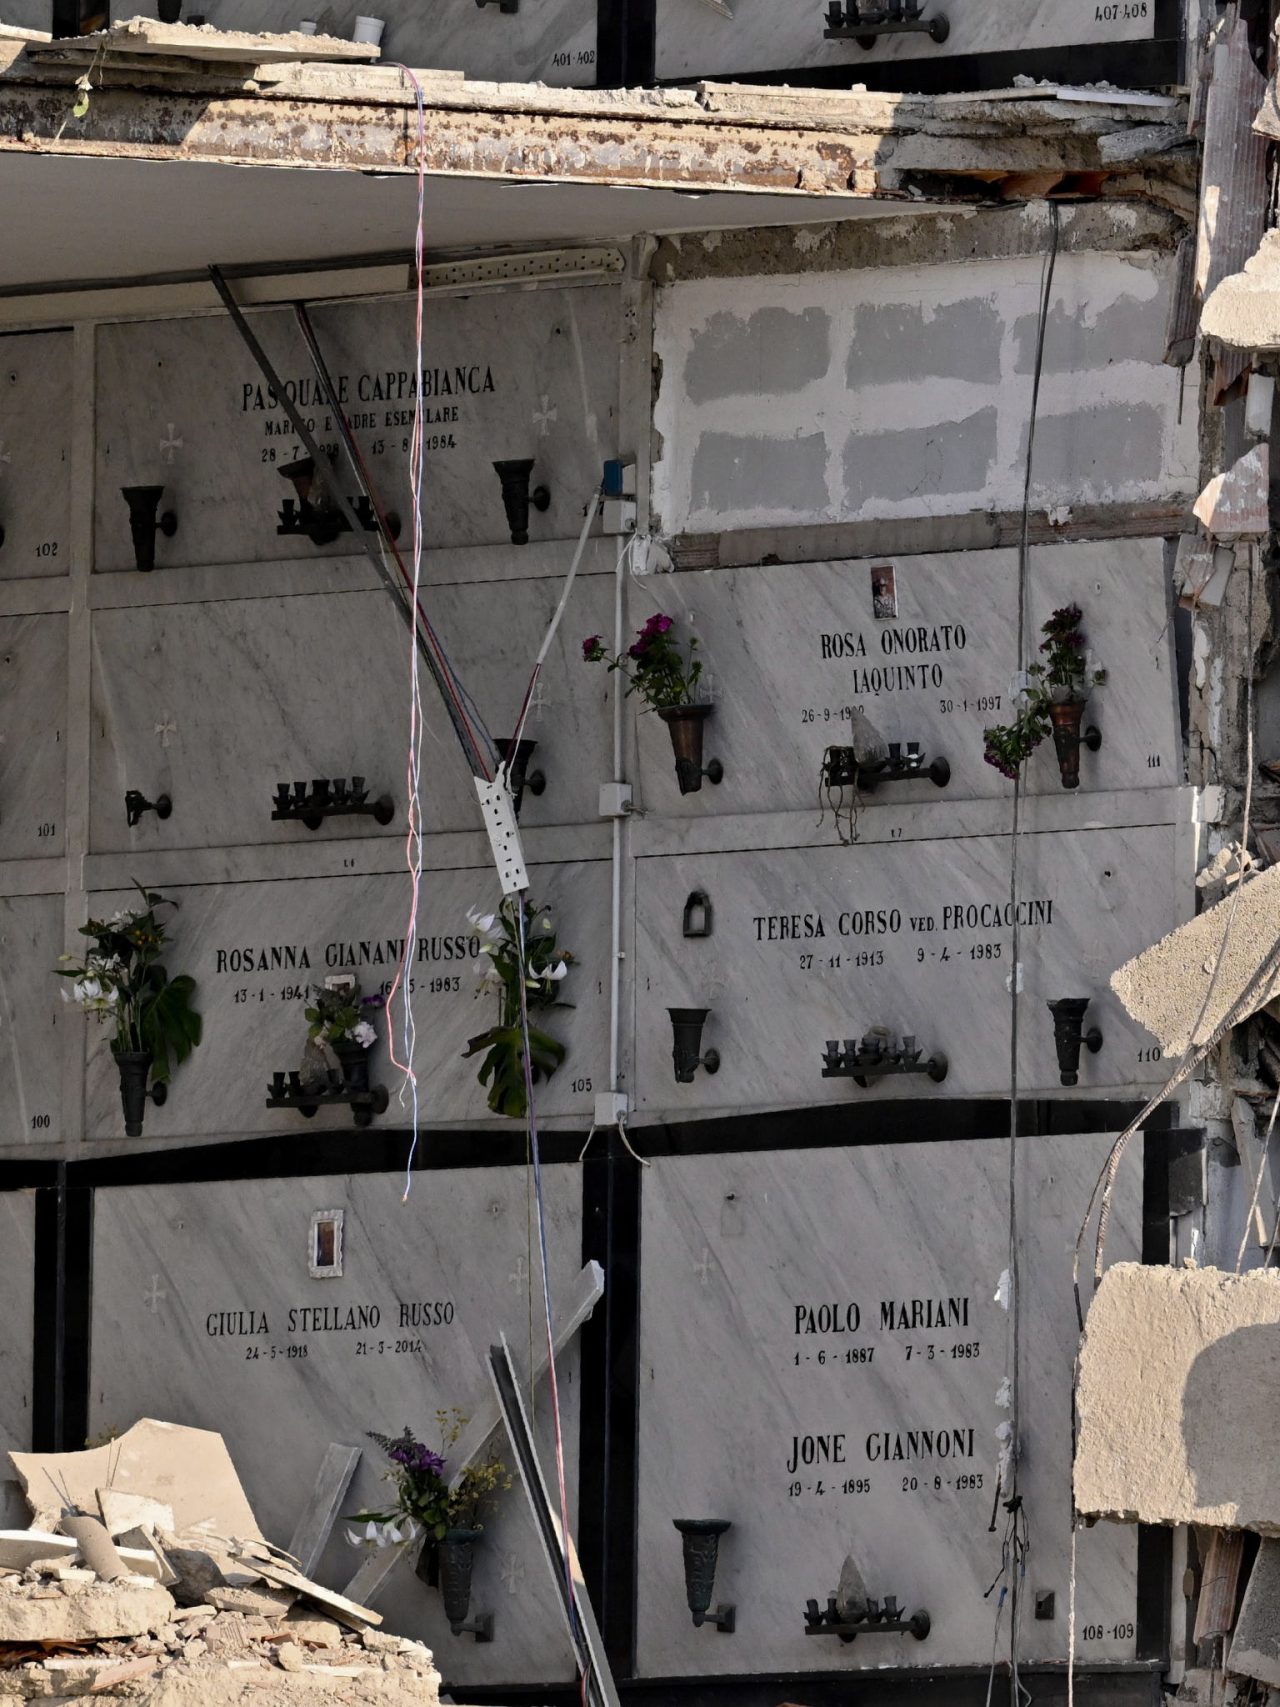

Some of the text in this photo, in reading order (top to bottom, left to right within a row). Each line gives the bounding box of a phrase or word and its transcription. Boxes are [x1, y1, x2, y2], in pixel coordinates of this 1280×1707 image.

[242, 366, 496, 411] PASQUAE CAPPABIANCA
[264, 406, 459, 436] MARIO E ADRE ESEMLARE
[582, 501, 605, 517] 17
[36, 542, 58, 557] 102
[821, 625, 966, 659] ROSA ONORATO
[853, 664, 943, 695] IAQUINTO
[38, 823, 55, 837] 101
[753, 900, 1053, 940] TERESA CORSO VED. PROCACCINI
[216, 935, 481, 973] ROSANNA GIANANI RUSSO
[1138, 1046, 1161, 1063] 110
[571, 1078, 592, 1093] 105
[32, 1115, 50, 1129] 100
[206, 1302, 454, 1336] GIULIA STELLANO RUSSO
[794, 1297, 969, 1334] PAOLO MARIANI
[787, 1429, 975, 1474] JONE GIANNONI
